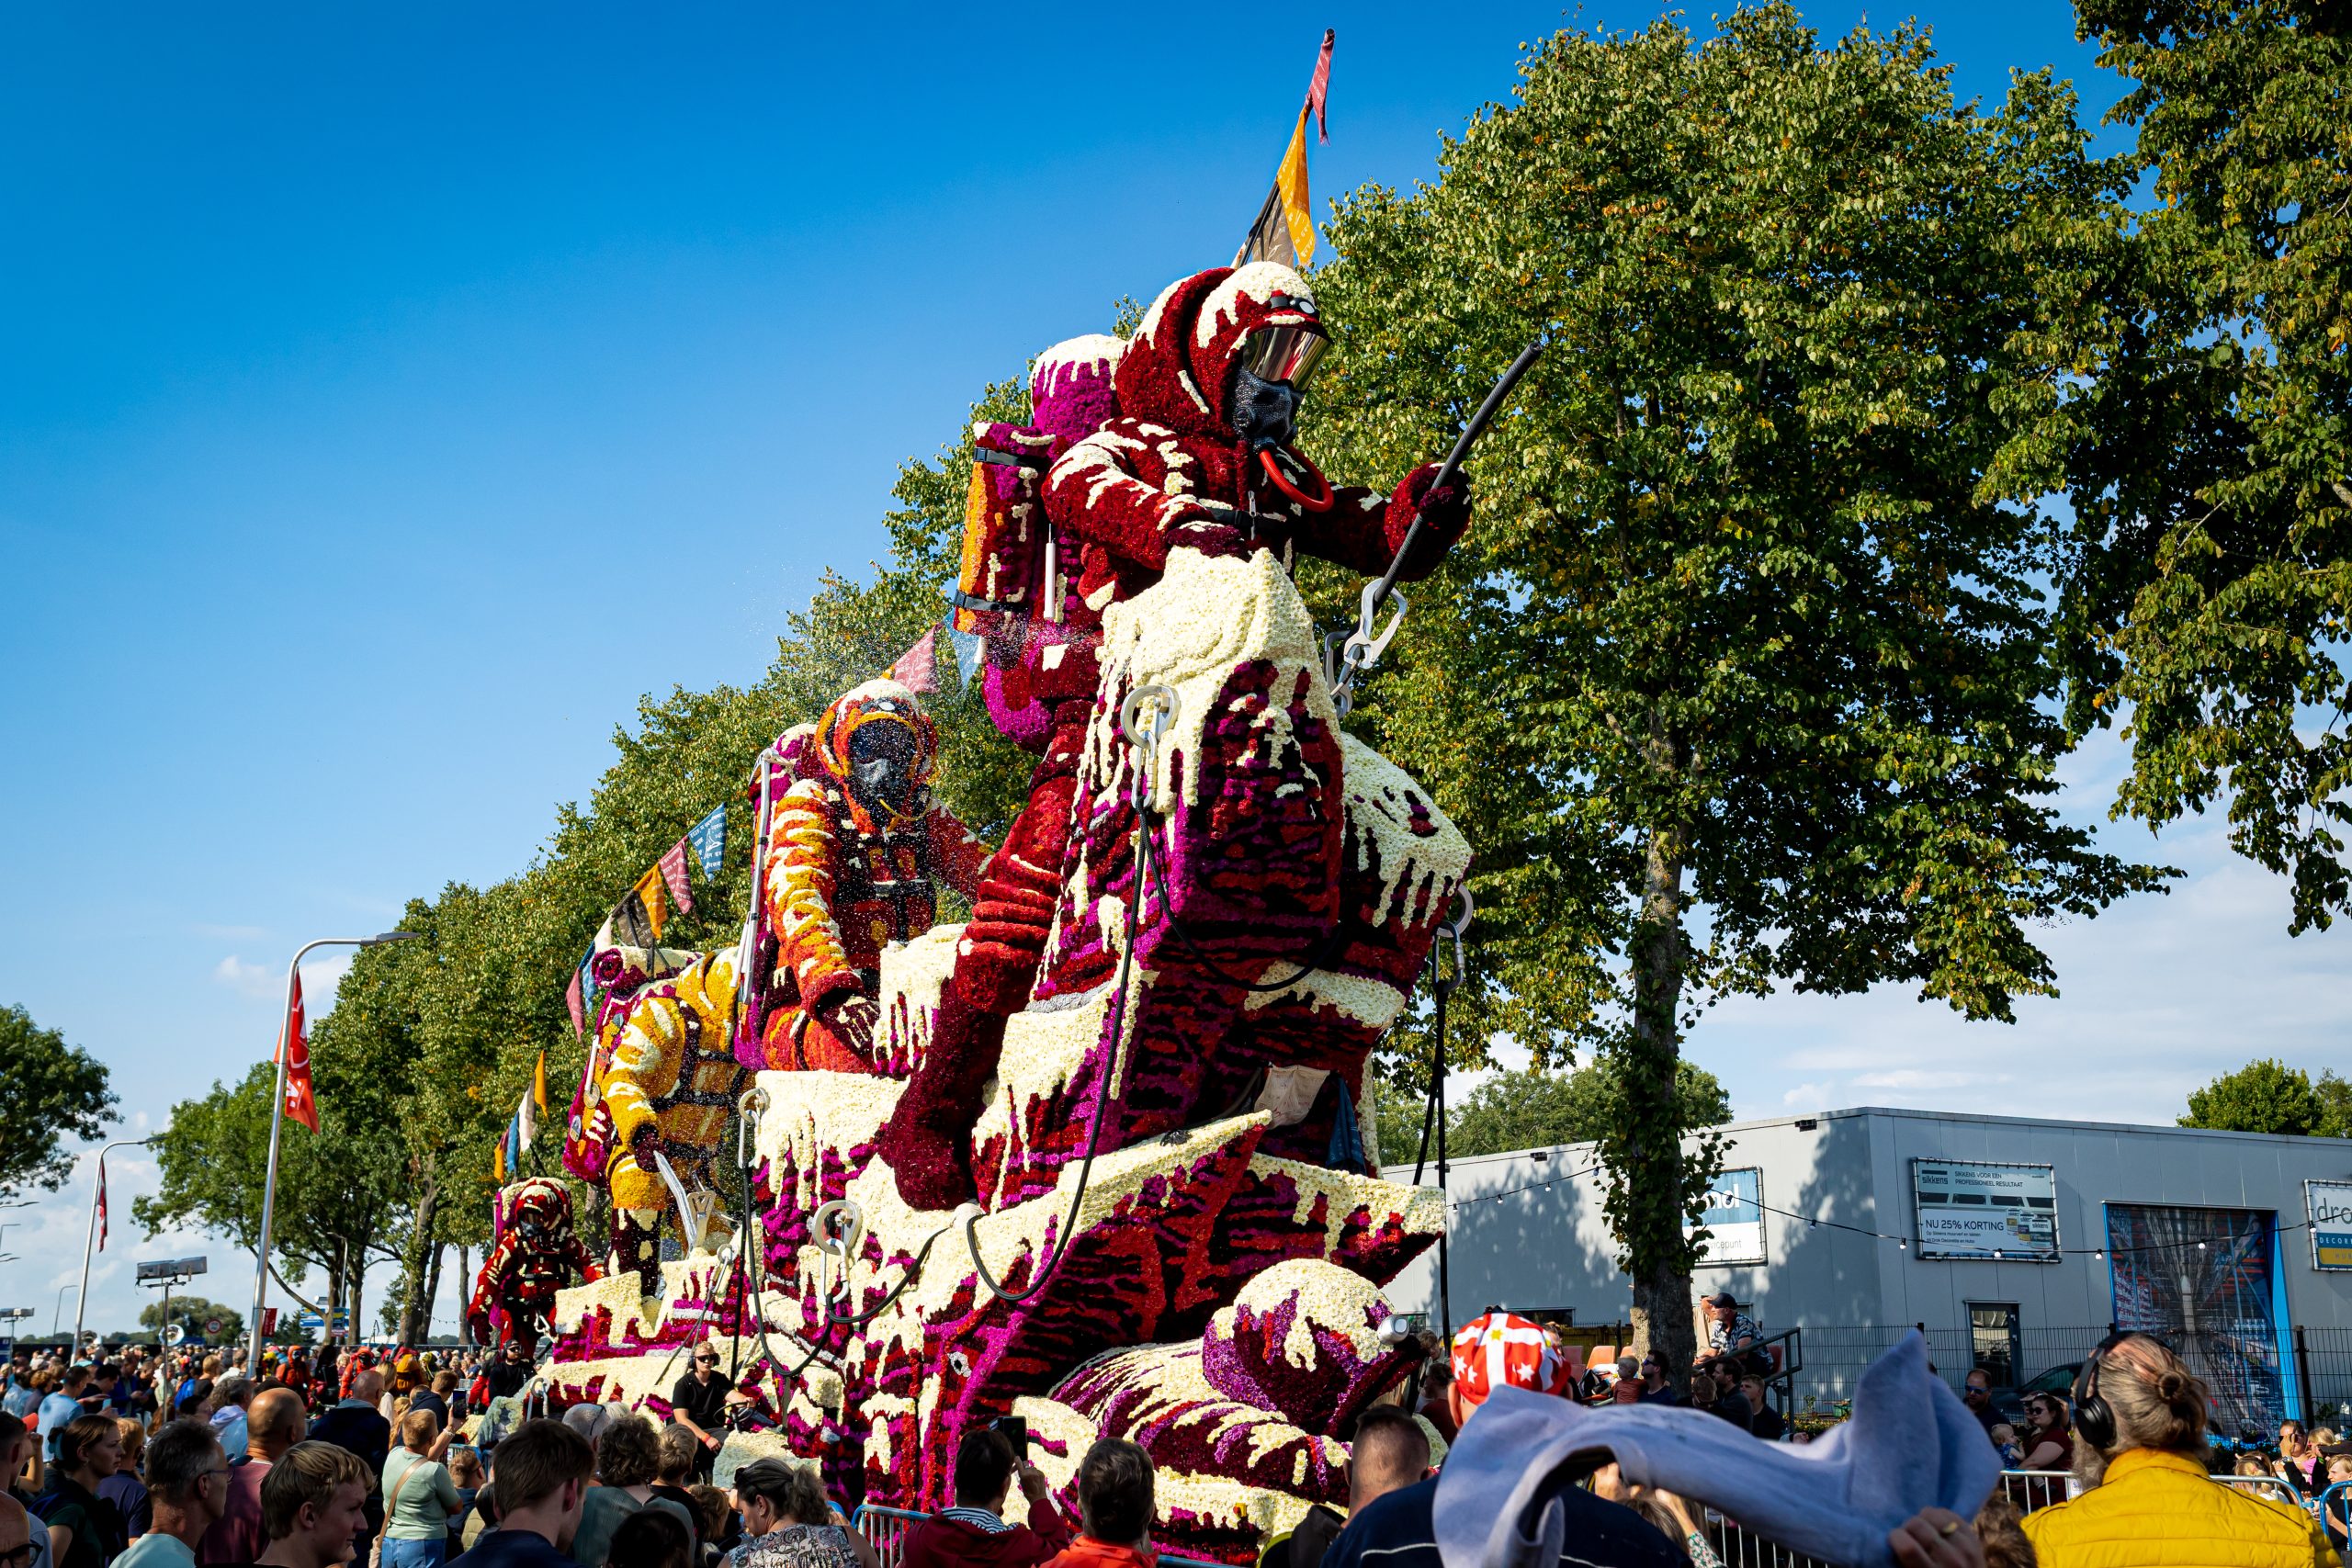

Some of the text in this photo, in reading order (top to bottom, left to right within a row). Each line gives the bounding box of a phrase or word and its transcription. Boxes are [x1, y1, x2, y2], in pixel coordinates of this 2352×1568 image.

[1922, 1176, 1948, 1184] sikkens
[1926, 1219, 2004, 1231] NU 25% KORTING
